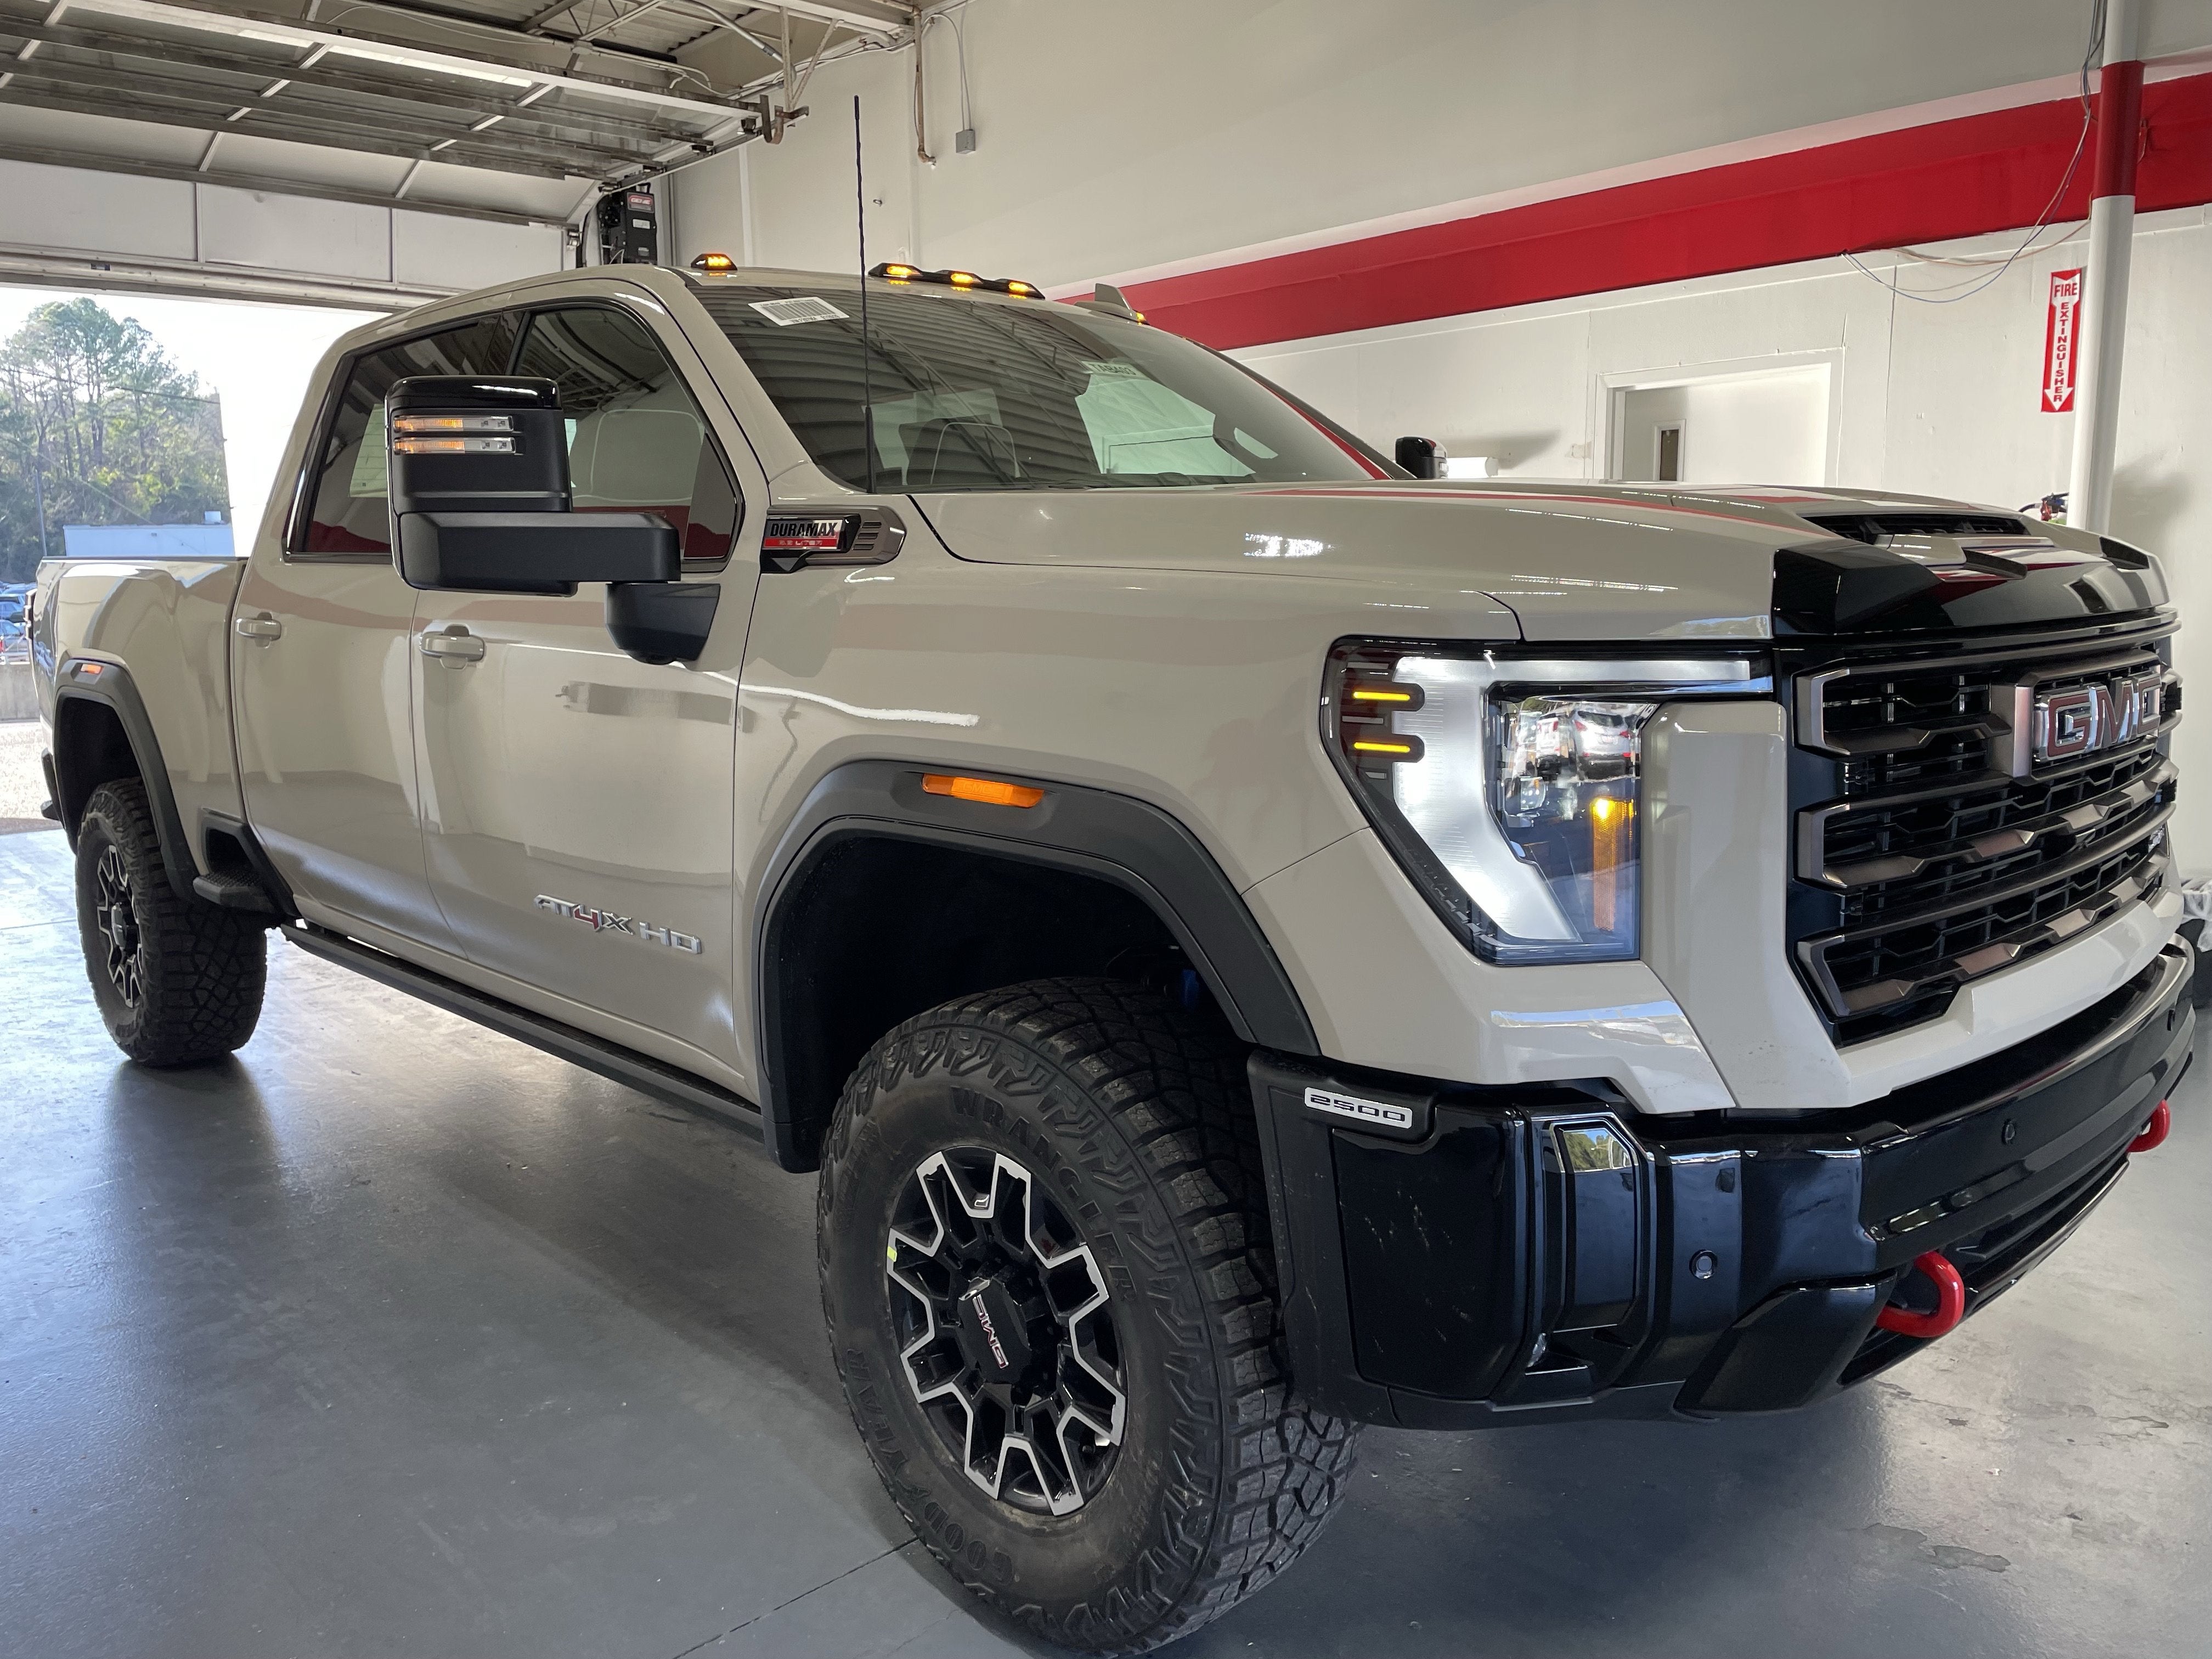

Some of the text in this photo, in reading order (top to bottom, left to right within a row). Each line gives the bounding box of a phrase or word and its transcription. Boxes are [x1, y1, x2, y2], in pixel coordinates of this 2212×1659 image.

[2054, 283, 2078, 297] FIRE
[2053, 302, 2069, 402] EXTINGUISHER
[770, 522, 838, 537] DURAMAX
[2034, 672, 2162, 761] GMC
[963, 782, 992, 794] GMC
[534, 894, 703, 955] AT4X HD
[1310, 1094, 1406, 1122] 2500
[950, 1085, 1137, 1299] WRANGLER
[972, 1294, 1009, 1369] GMC
[847, 1348, 1014, 1587] GOODYEAR
